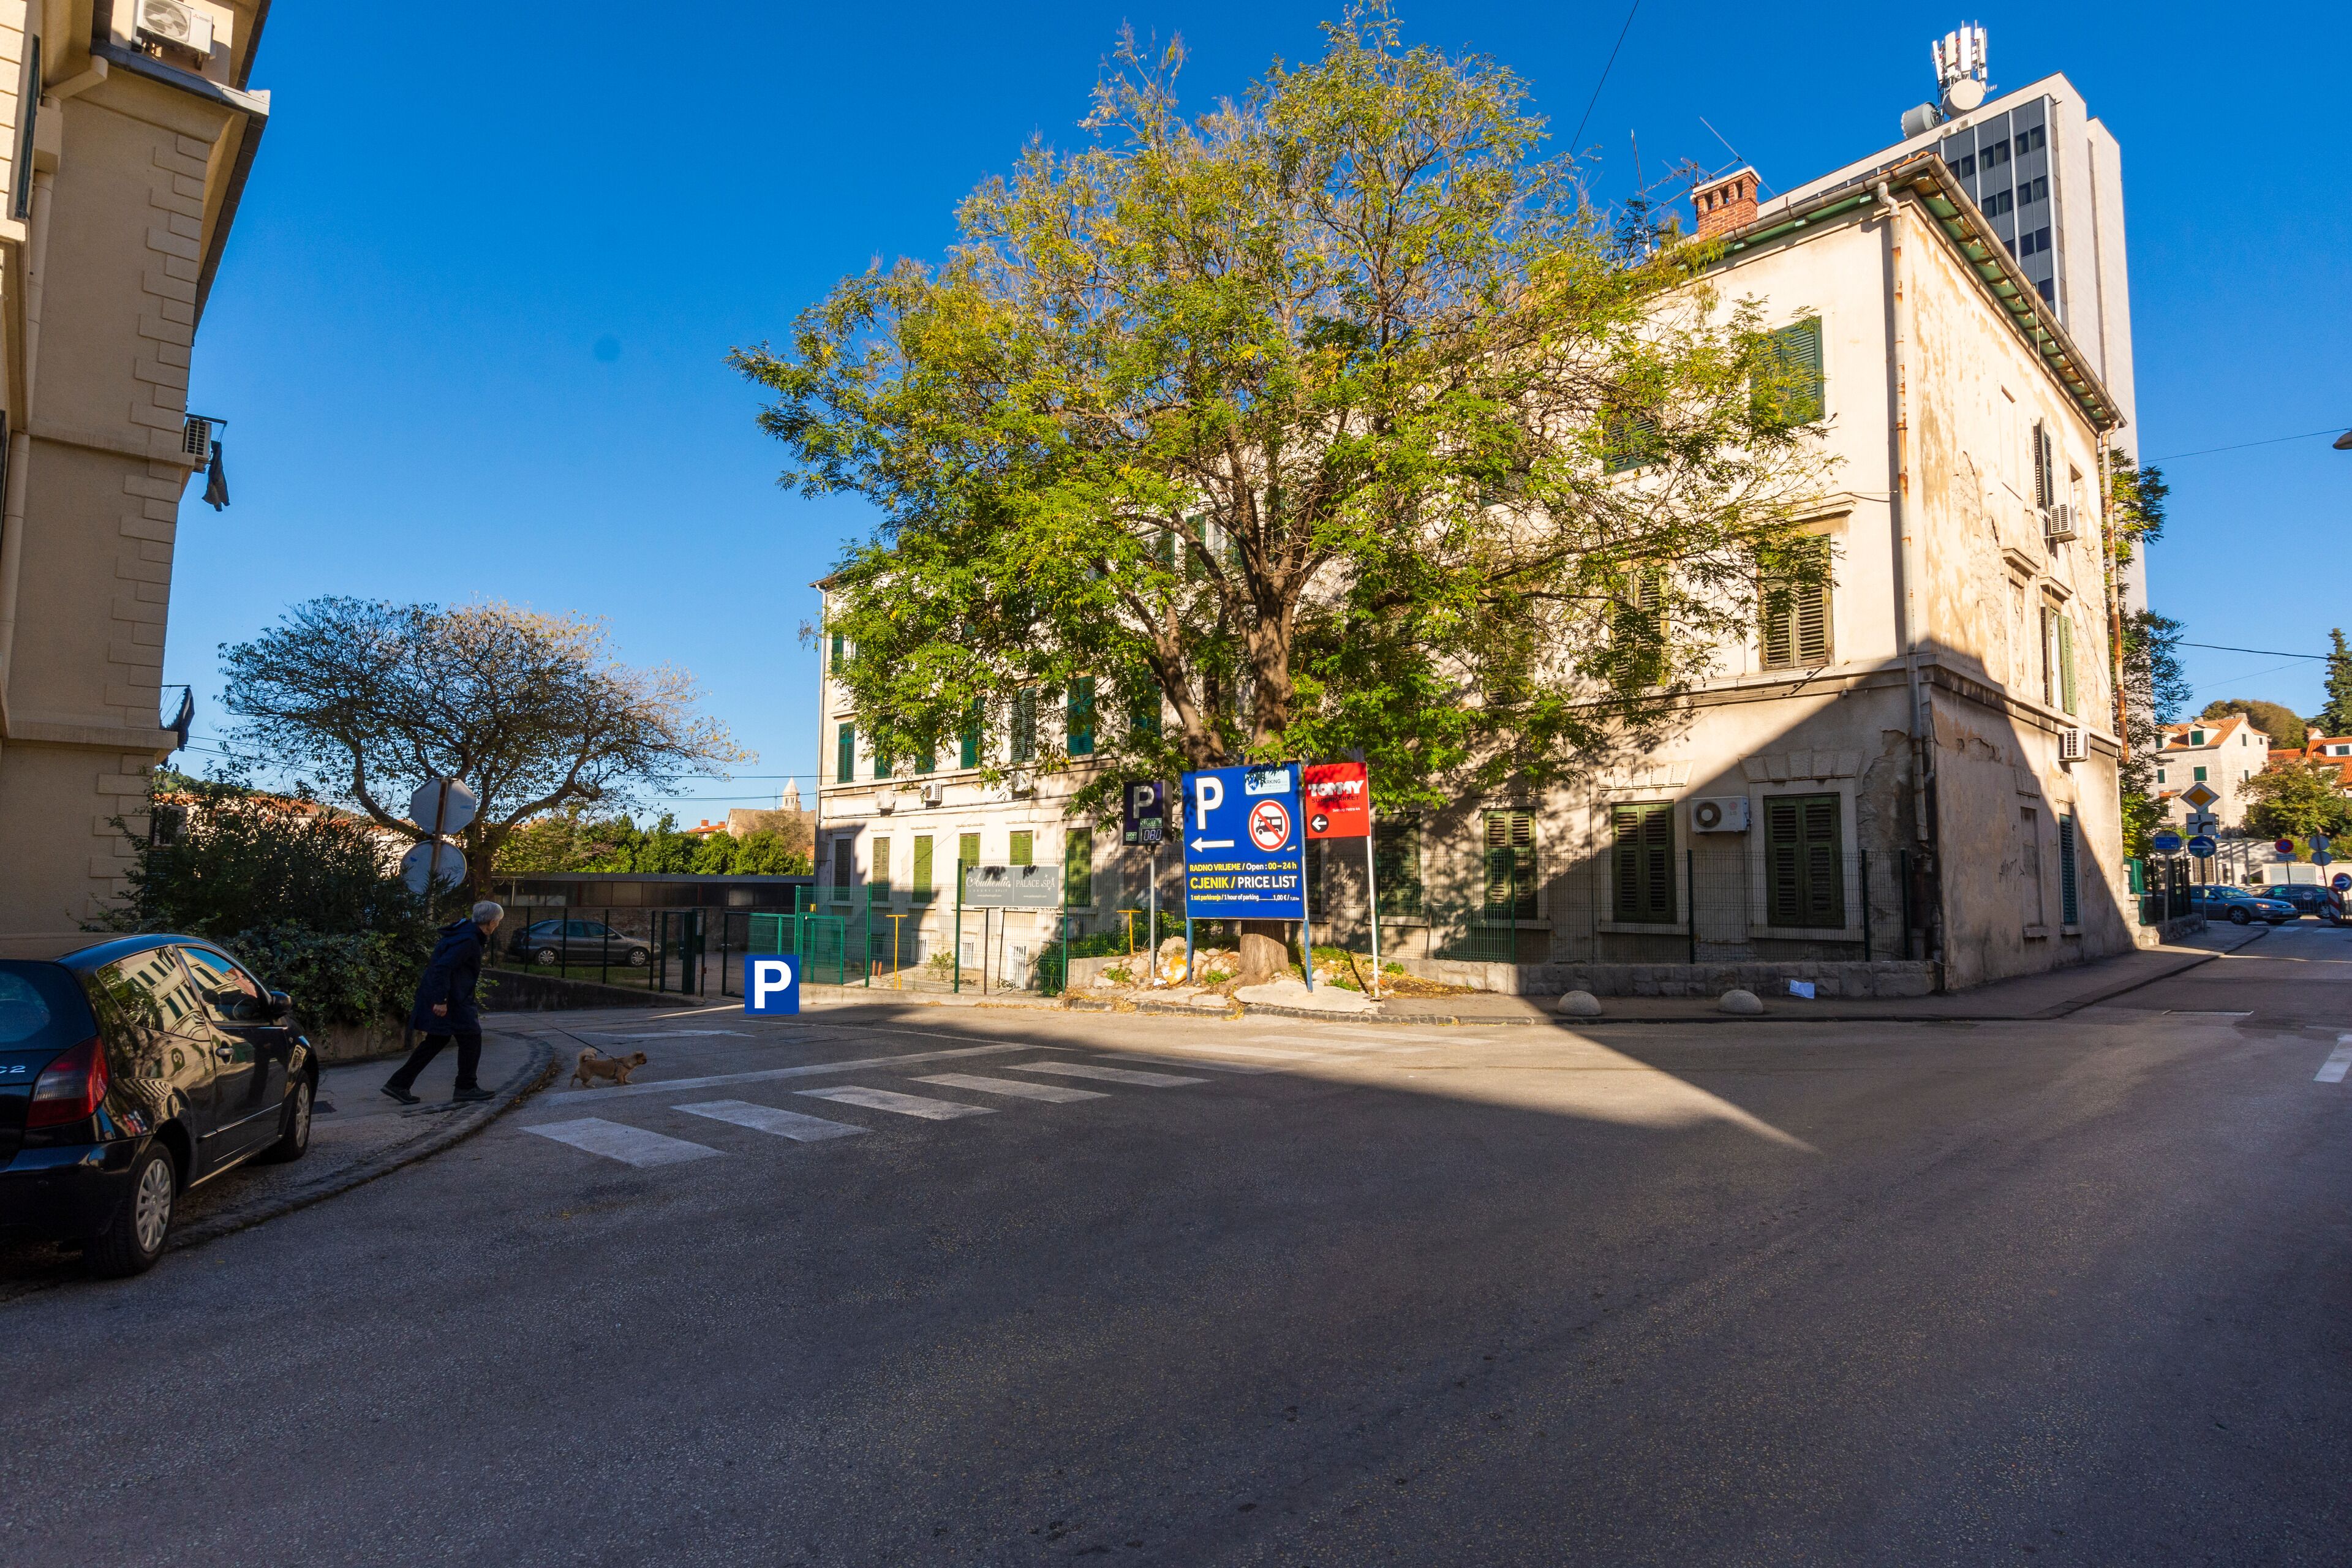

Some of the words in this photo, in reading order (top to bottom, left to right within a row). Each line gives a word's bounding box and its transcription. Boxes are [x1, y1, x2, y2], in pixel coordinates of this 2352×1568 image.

[1308, 780, 1364, 796] TOMMY
[1133, 786, 1154, 818] P
[1196, 777, 1223, 829] P
[1144, 829, 1162, 841] 080
[1246, 863, 1264, 872] Open
[967, 872, 1011, 887] Authentic
[1042, 879, 1055, 888] SPA
[1190, 877, 1229, 889] CJENIK
[1238, 876, 1270, 888] PRICE
[1272, 875, 1297, 888] LIST
